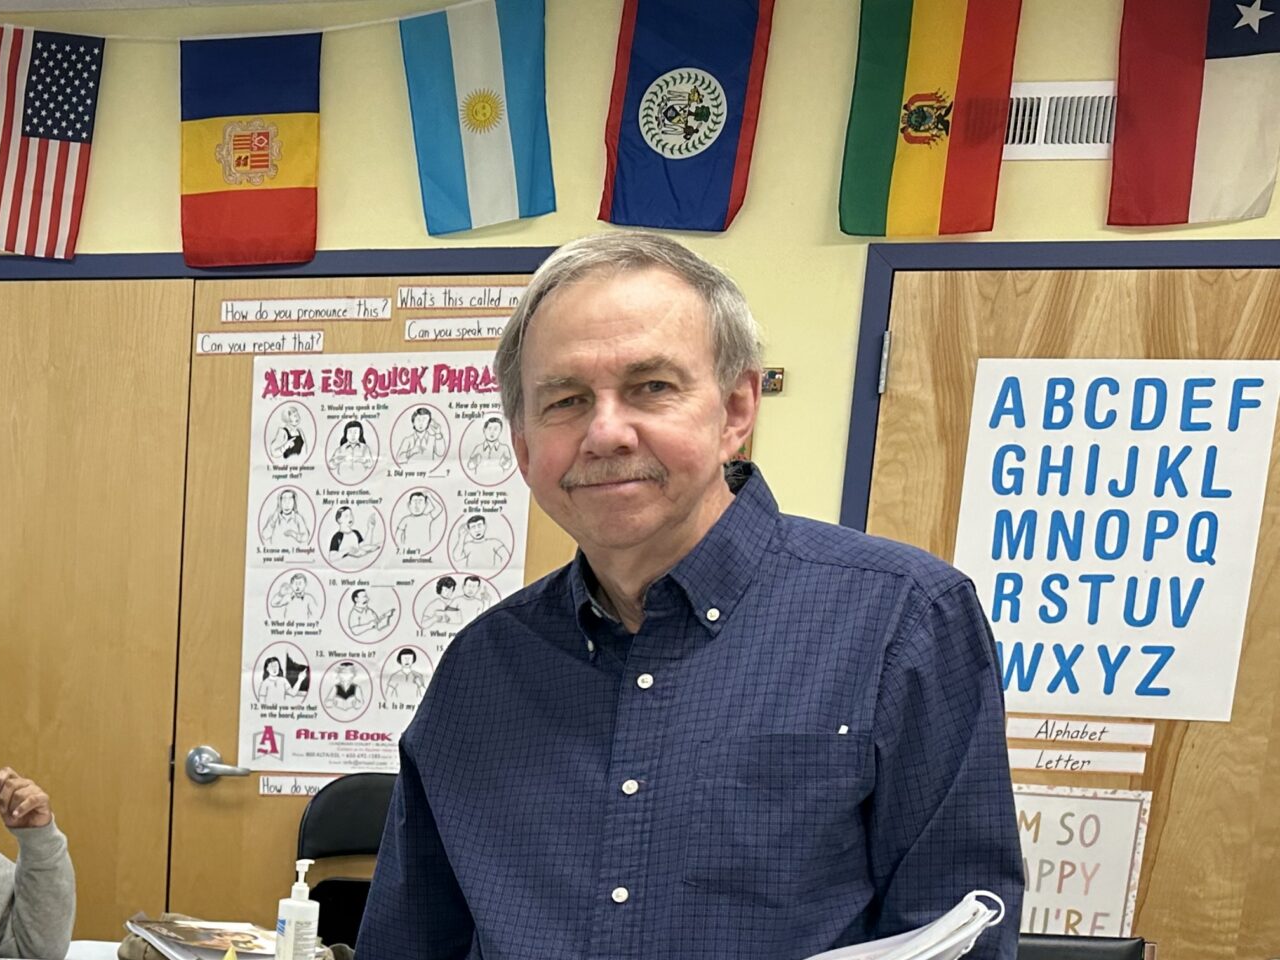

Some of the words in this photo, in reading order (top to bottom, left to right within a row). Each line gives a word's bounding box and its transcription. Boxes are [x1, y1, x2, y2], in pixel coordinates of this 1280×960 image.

[399, 287, 435, 308] What's
[439, 288, 463, 307] this
[469, 287, 502, 307] called
[225, 303, 248, 321] How
[255, 302, 268, 320] do
[274, 309, 291, 322] you
[297, 306, 348, 322] pronounce
[407, 321, 430, 340] Can
[434, 328, 452, 342] you
[455, 320, 481, 341] speak
[200, 334, 223, 353] Can
[228, 342, 246, 354] you
[252, 334, 287, 354] repeat
[293, 332, 322, 352] that?
[261, 368, 315, 399] ALTA
[320, 366, 357, 396] ESL
[361, 365, 430, 401] QUICK
[295, 728, 339, 741] ALTA
[345, 729, 393, 742] BOOK
[1034, 719, 1110, 743] Alphabet
[1035, 749, 1091, 771] Letter
[262, 777, 283, 794] How
[291, 778, 302, 794] do
[1055, 811, 1101, 848] SO
